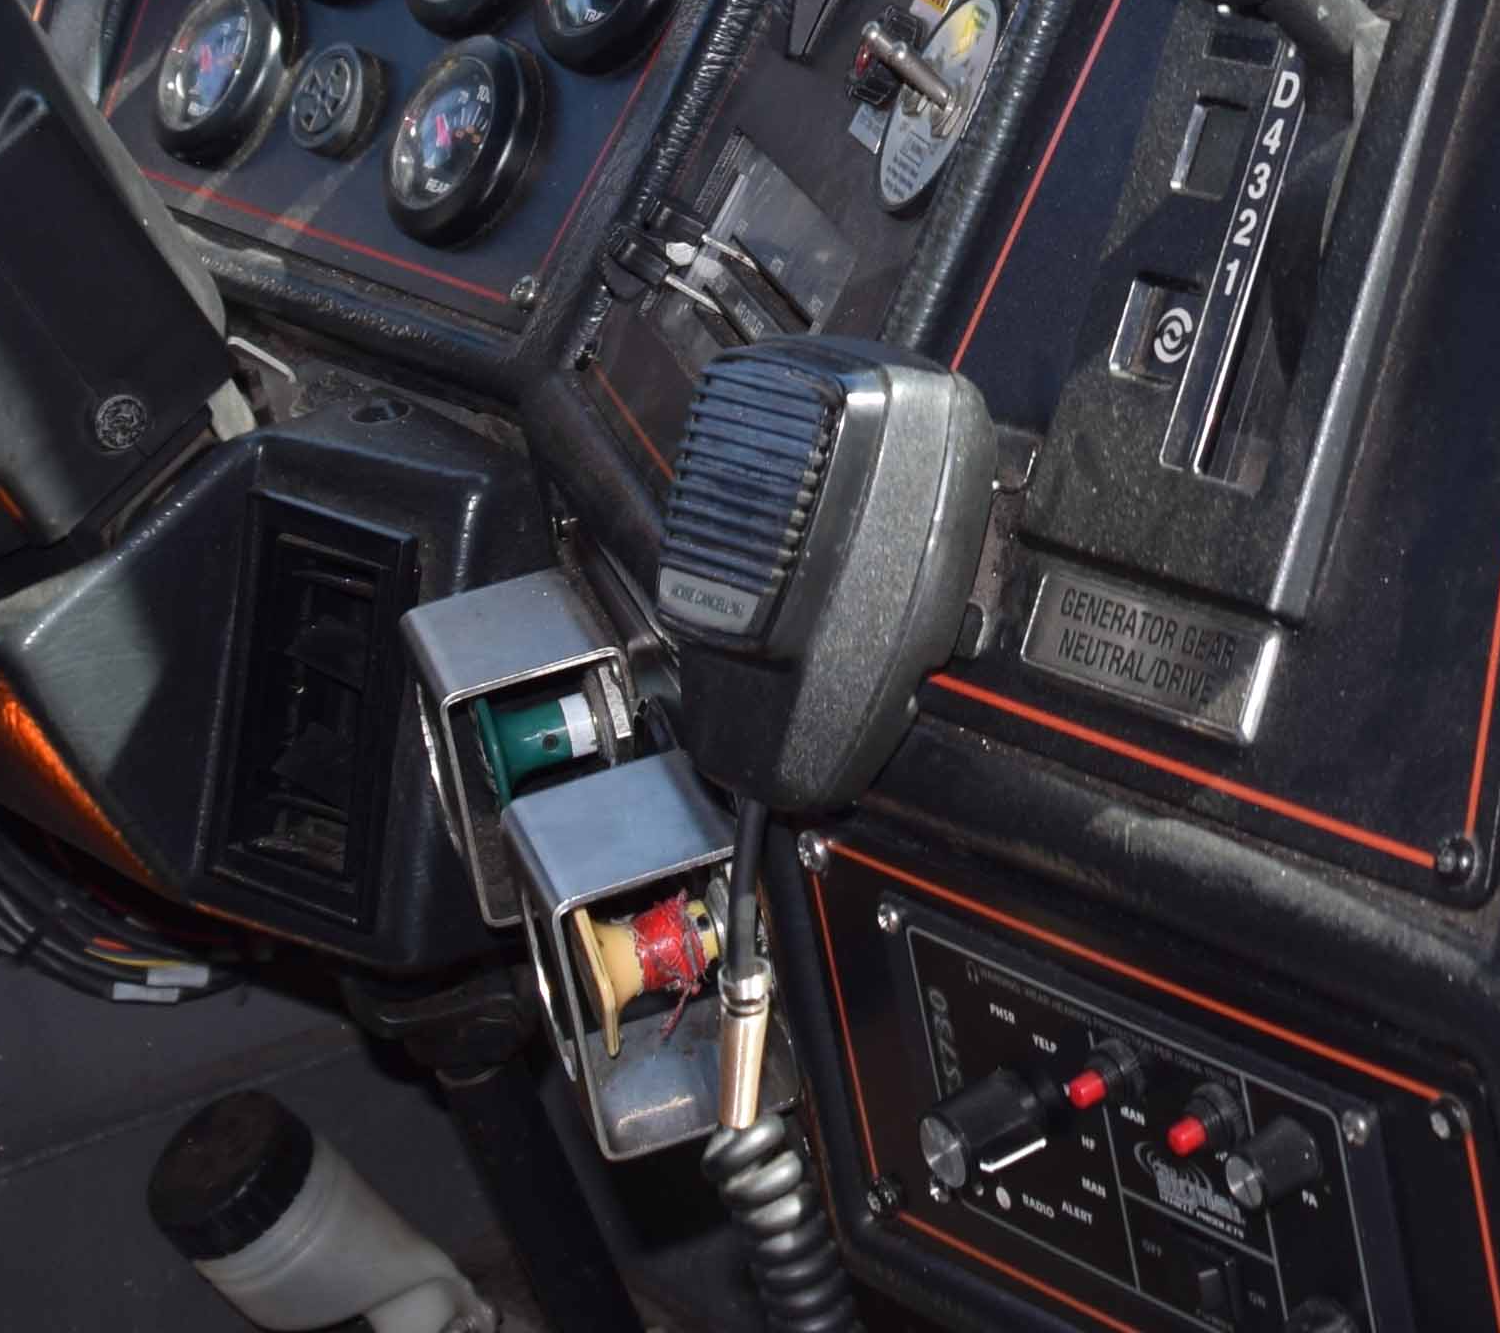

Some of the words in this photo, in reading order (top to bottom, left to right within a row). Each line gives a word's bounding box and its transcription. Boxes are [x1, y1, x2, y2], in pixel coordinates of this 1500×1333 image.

[1273, 70, 1301, 109] D
[1262, 118, 1285, 155] 4
[1248, 162, 1272, 199] 3
[1233, 209, 1258, 247] 2
[1224, 258, 1240, 296] 1
[1060, 588, 1179, 649] GENERATOR
[1181, 625, 1237, 670] GEAR
[1058, 628, 1216, 704] NEUTRAL/DRIVE
[1032, 1033, 1058, 1054] YELP
[1021, 1193, 1055, 1219] RADIO
[1061, 1200, 1093, 1226] ALERT
[1302, 1188, 1319, 1209] PA
